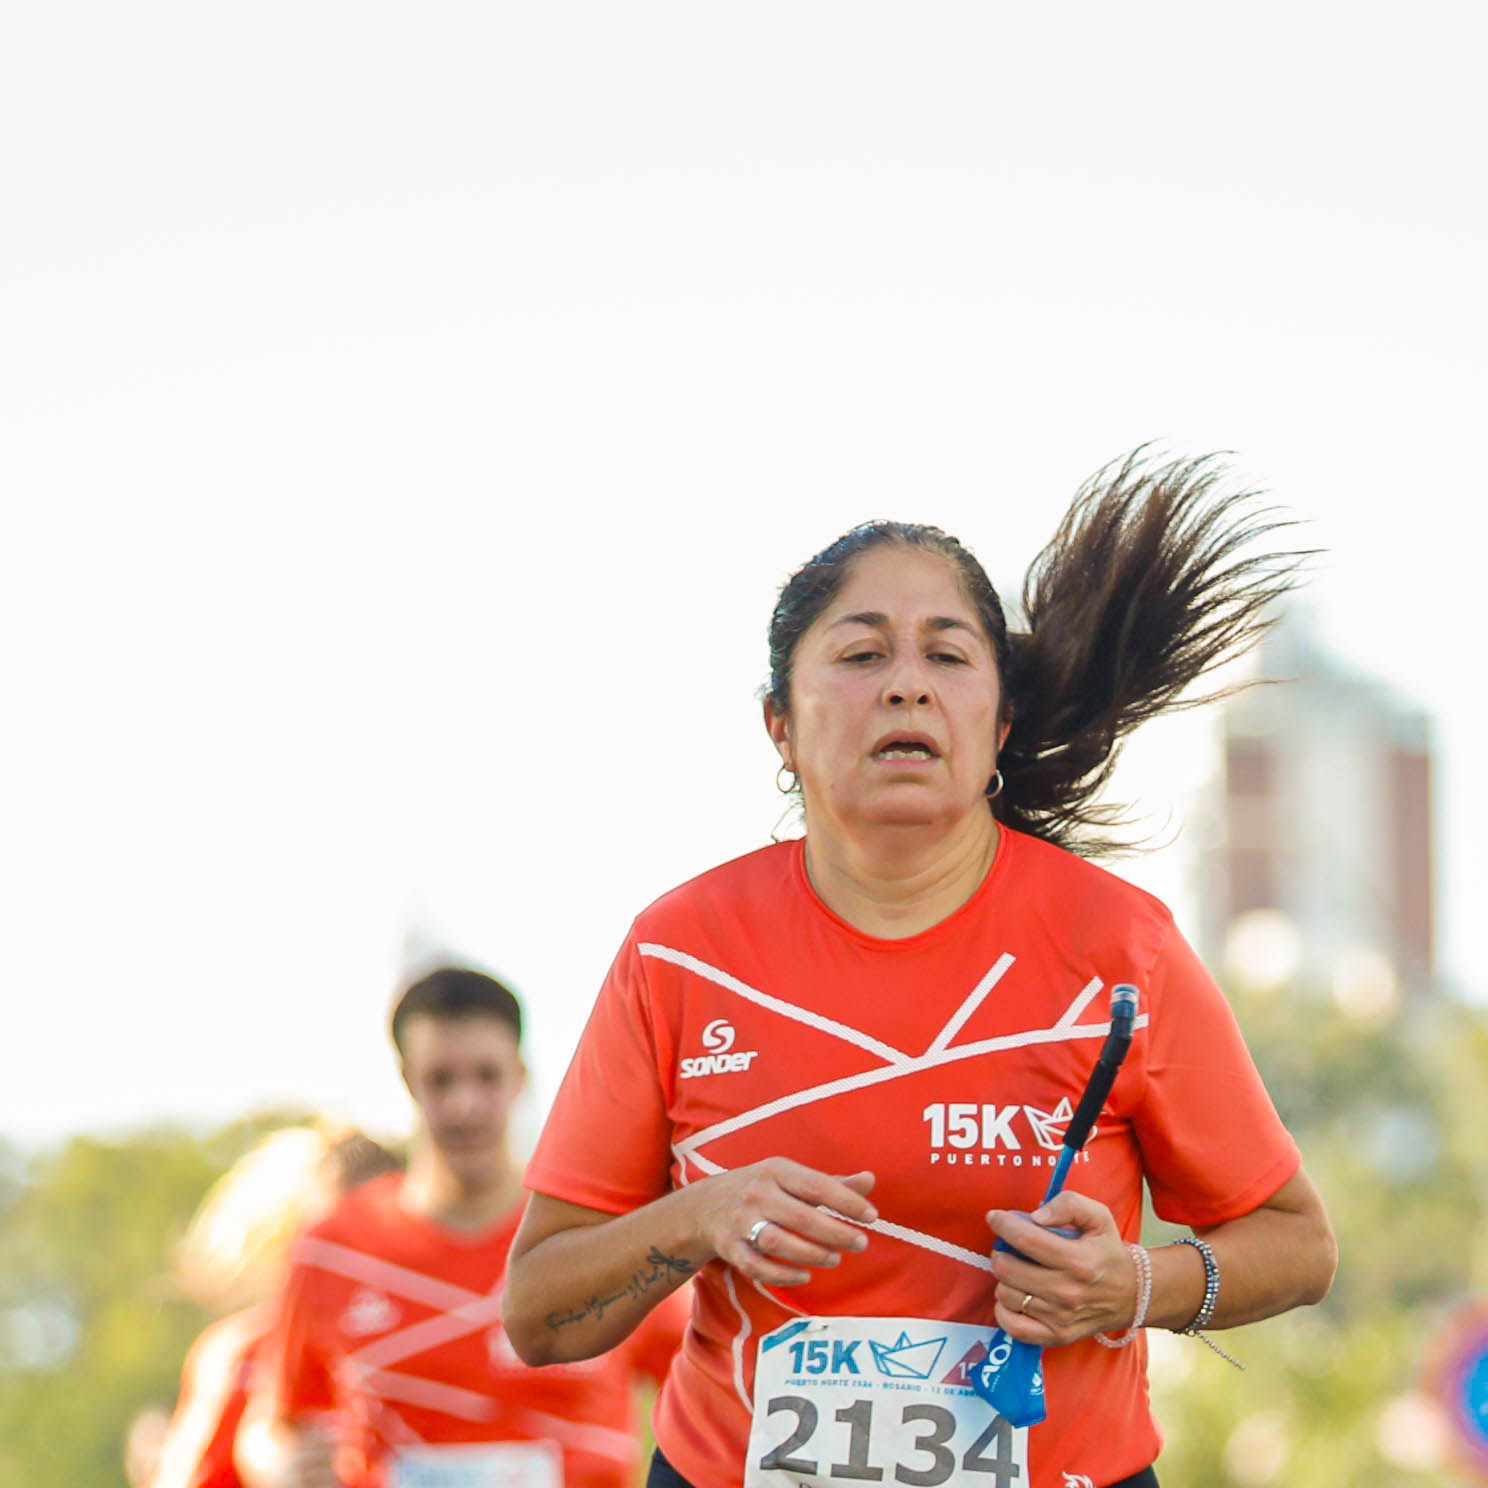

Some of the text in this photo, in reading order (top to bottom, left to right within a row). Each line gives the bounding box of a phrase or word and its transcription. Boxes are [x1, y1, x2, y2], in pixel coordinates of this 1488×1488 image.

[922, 1102, 1022, 1150] 15K
[930, 1150, 1090, 1167] PUERTO NOTE
[788, 1340, 863, 1375] 15K
